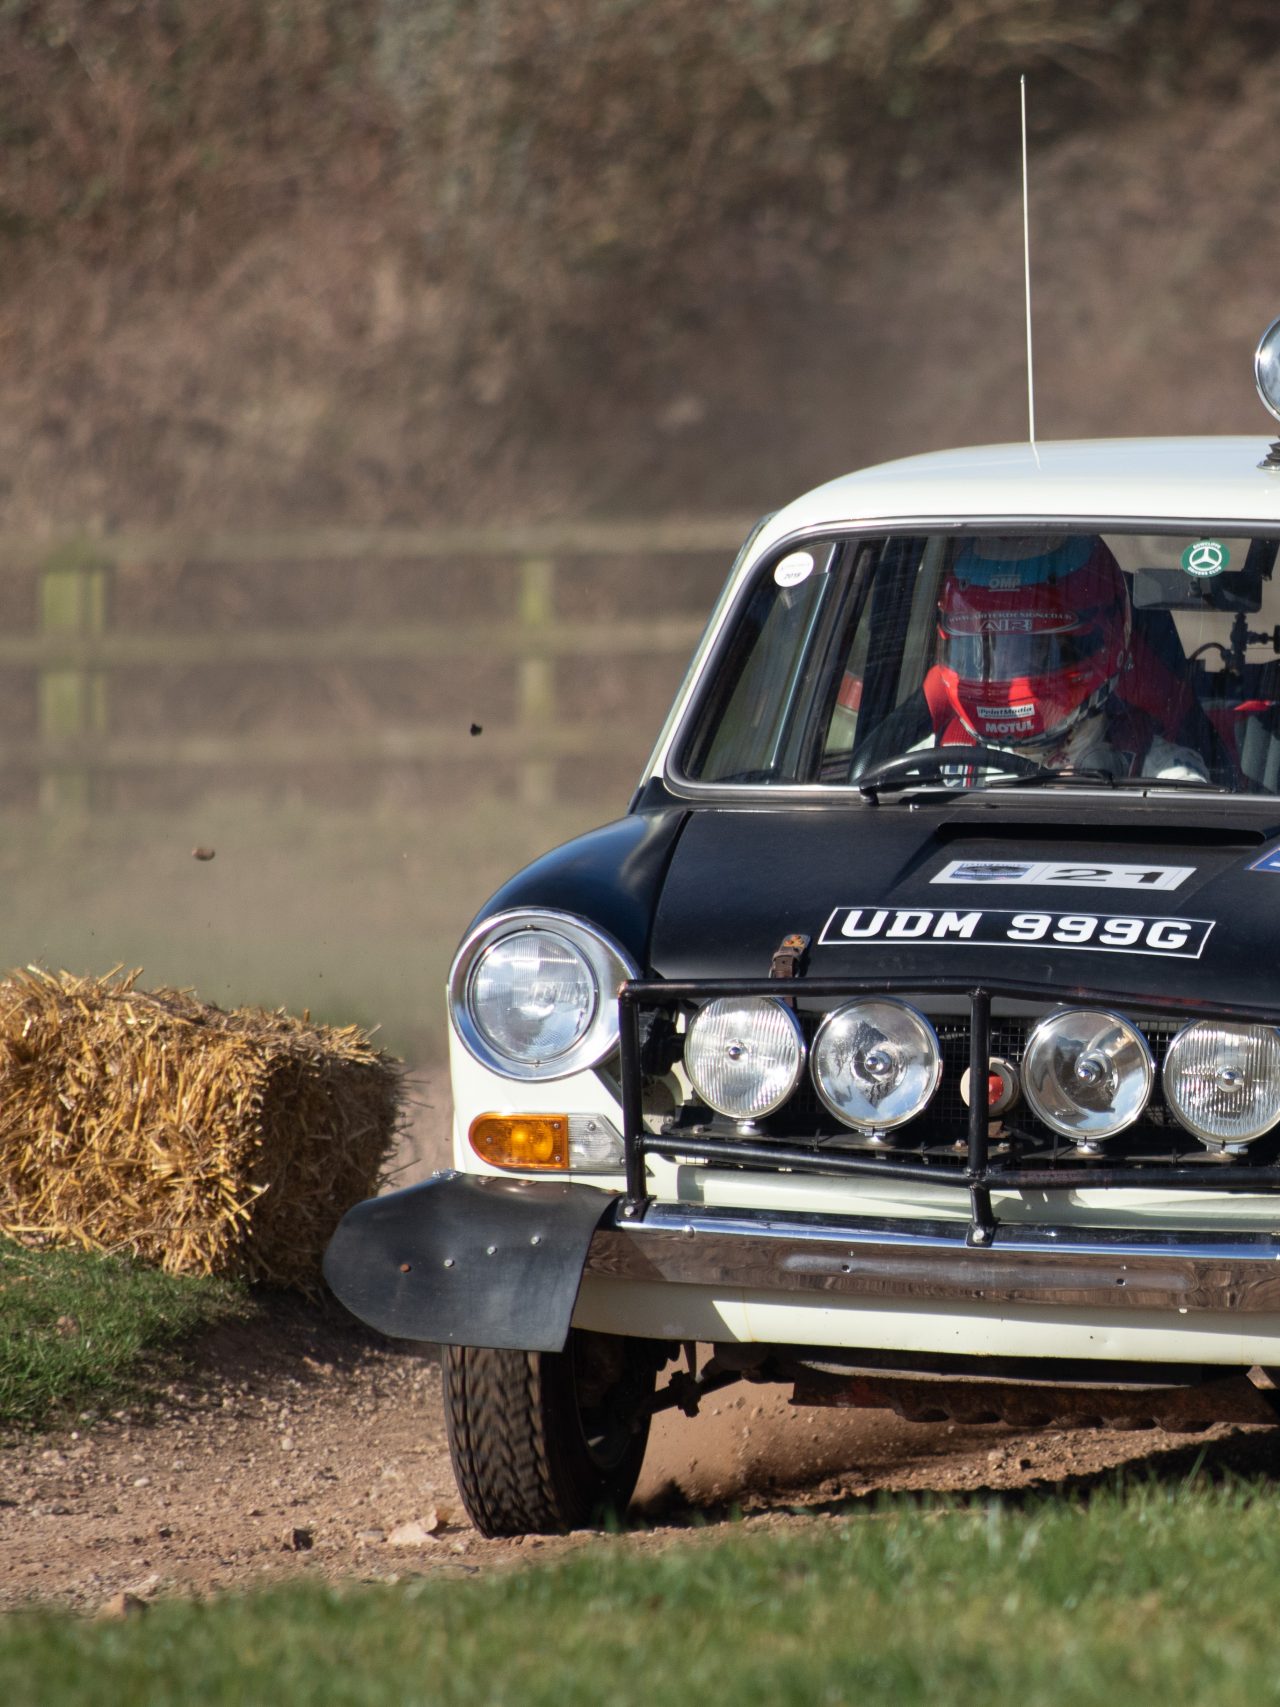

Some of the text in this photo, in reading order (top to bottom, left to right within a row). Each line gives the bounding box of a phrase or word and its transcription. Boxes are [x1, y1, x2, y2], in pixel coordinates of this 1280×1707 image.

[988, 577, 1021, 589] OMP
[985, 720, 1035, 733] MOTUL
[1046, 868, 1166, 884] 21
[840, 910, 1192, 950] UDM 999G
